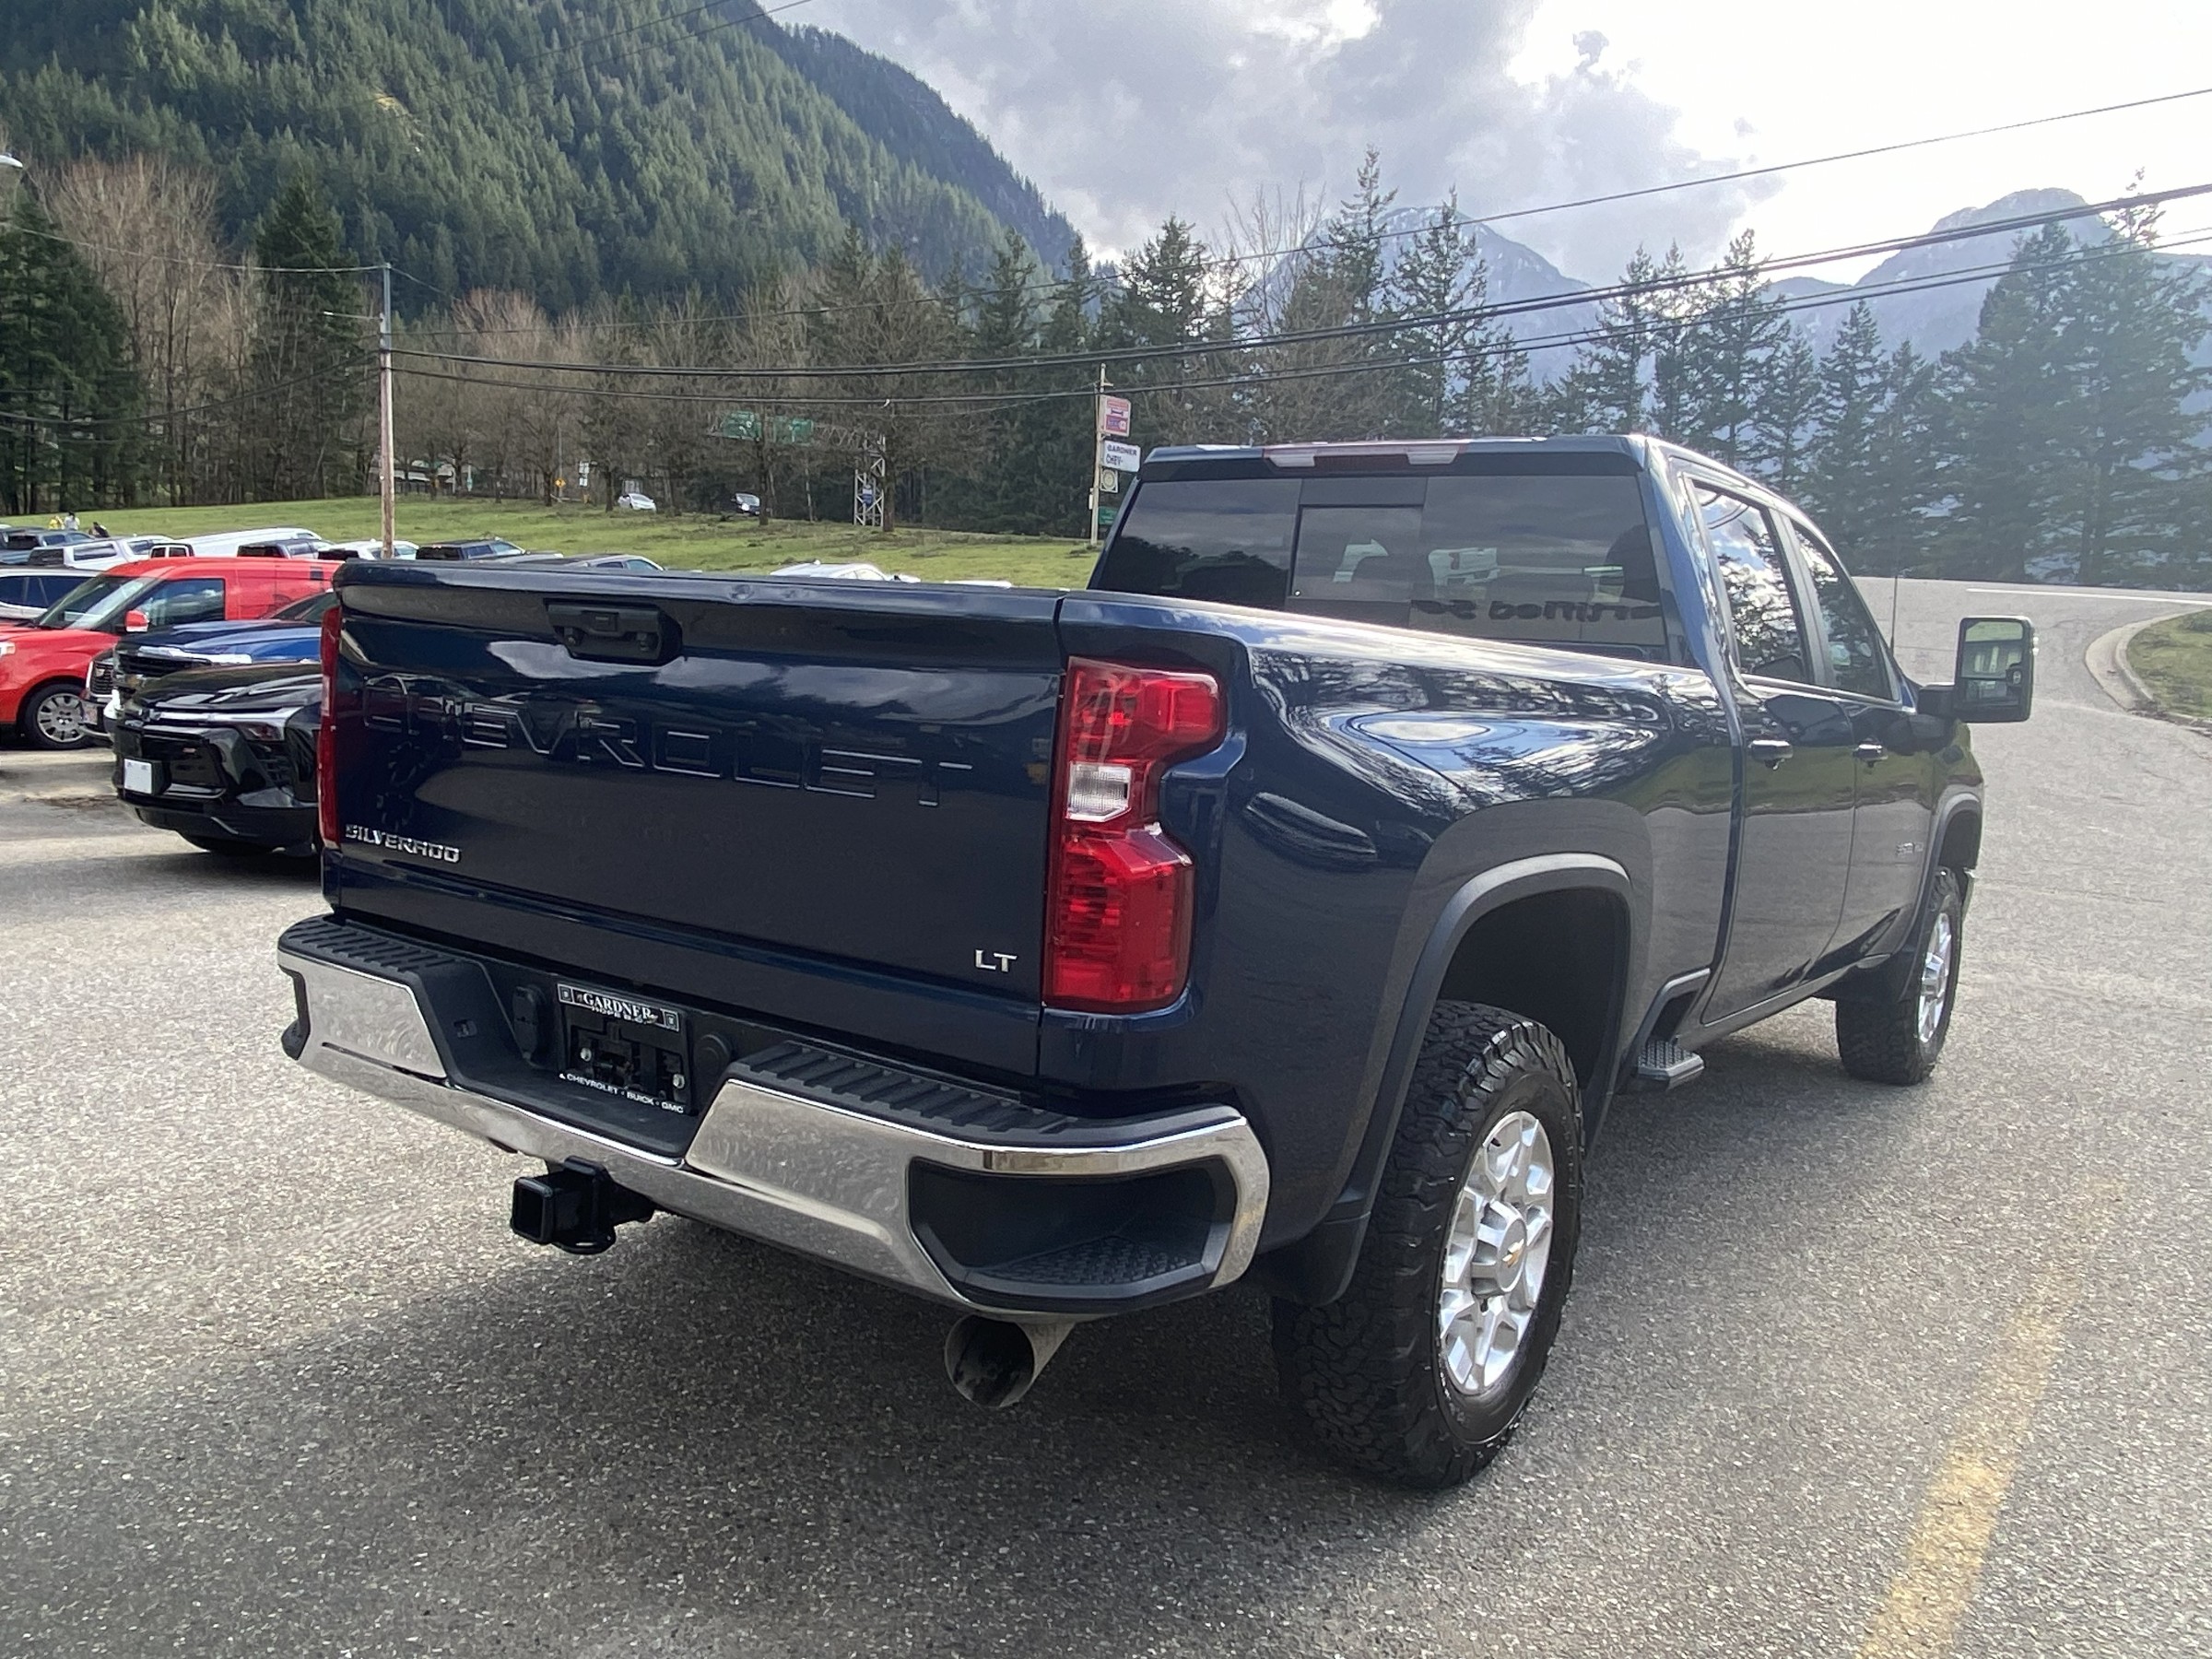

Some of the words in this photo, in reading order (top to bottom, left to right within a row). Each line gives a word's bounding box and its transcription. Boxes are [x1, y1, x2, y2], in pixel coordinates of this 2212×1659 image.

[1107, 443, 1137, 456] GARDNER
[363, 676, 973, 807] CHEVROLET
[345, 824, 460, 864] SILVERADO
[975, 949, 1018, 972] LT
[583, 993, 652, 1020] GARDNER
[567, 1073, 618, 1095] CHEVROLET
[627, 1091, 654, 1105] BUICK
[661, 1101, 684, 1113] GMC
